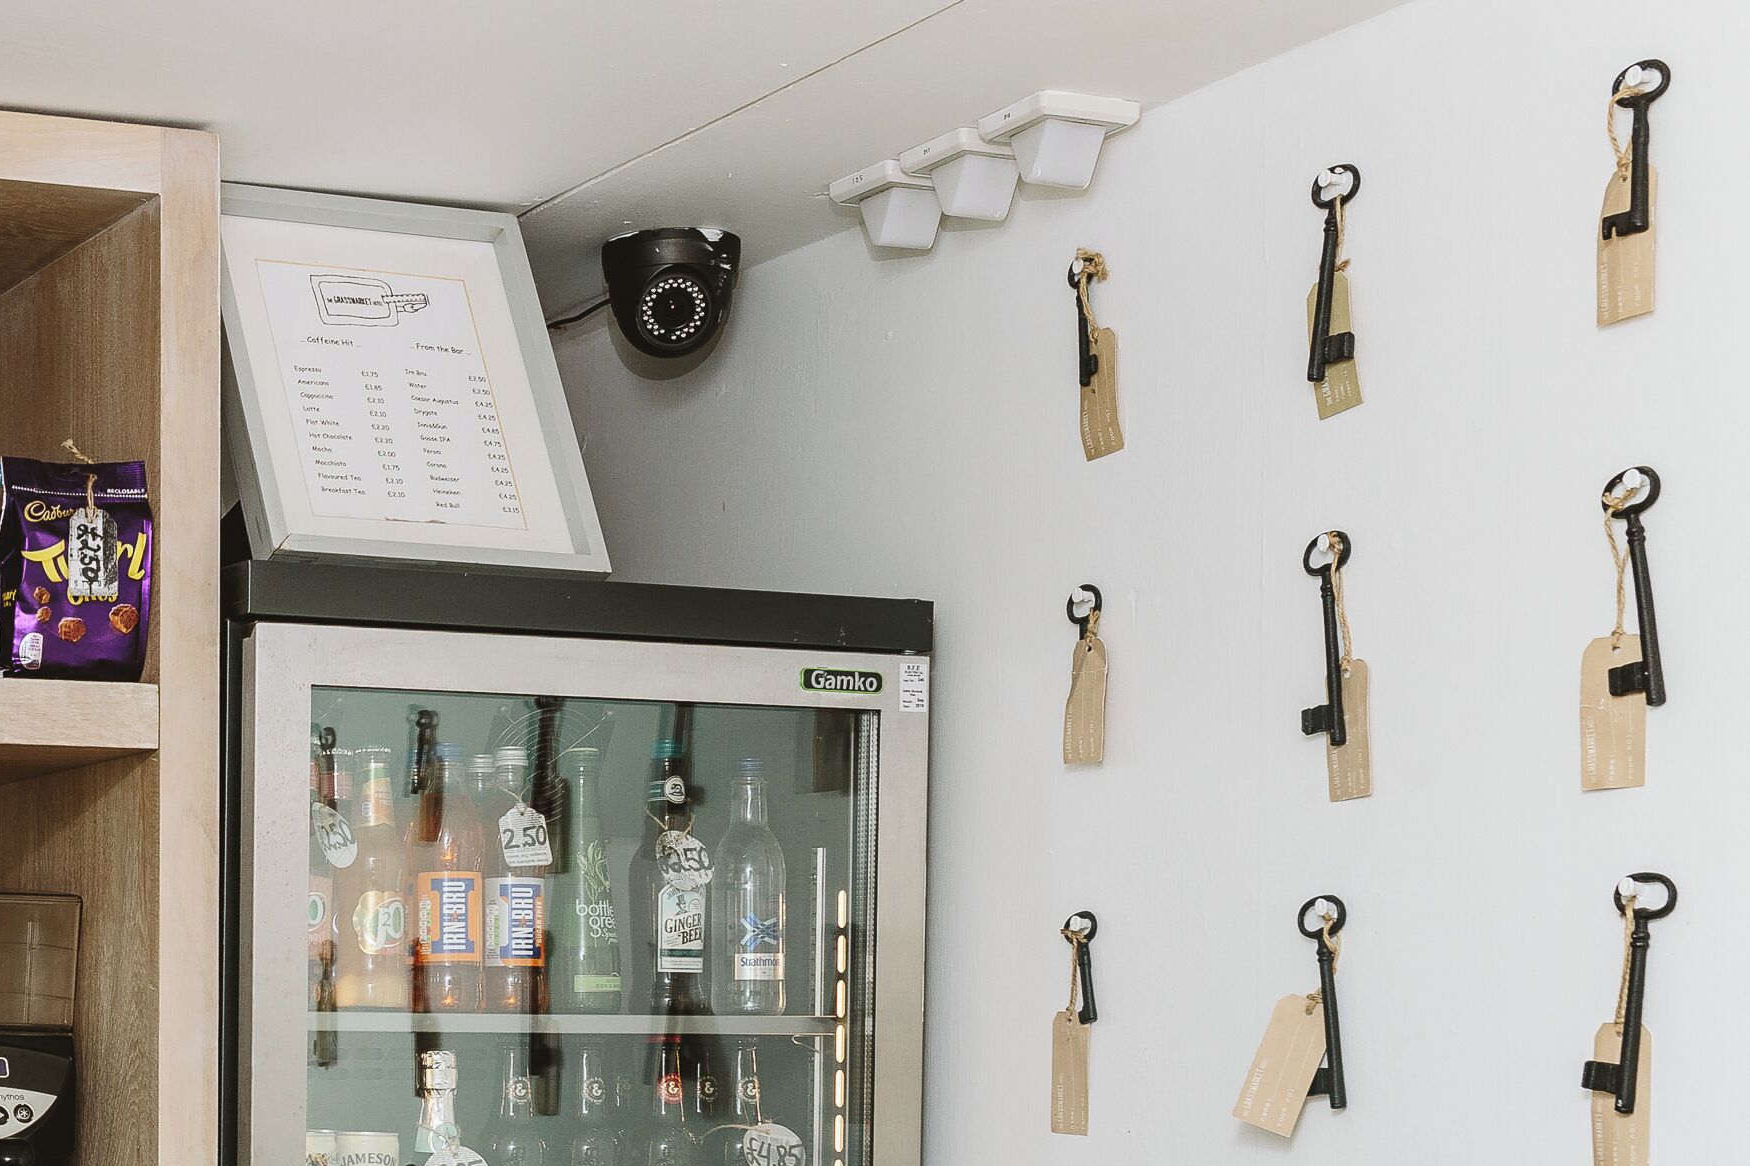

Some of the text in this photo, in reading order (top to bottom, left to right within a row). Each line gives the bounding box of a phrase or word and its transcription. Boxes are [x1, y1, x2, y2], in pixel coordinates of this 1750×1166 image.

[306, 336, 354, 347] Caffeine Hit
[415, 342, 464, 355] From the Bar
[293, 365, 322, 374] Espresso
[297, 379, 330, 387] Americano
[300, 391, 334, 400] Cappuccino
[302, 405, 320, 413] Latte
[320, 419, 340, 427] White
[322, 433, 353, 441] Chocolate
[317, 472, 348, 480] Flavoured
[429, 474, 460, 482] Budweiser
[106, 487, 146, 496] RECLOSABLE
[321, 486, 352, 494] Breakfast
[432, 488, 461, 496] Heineken
[810, 670, 878, 692] Gamko
[502, 823, 548, 850] 2.50
